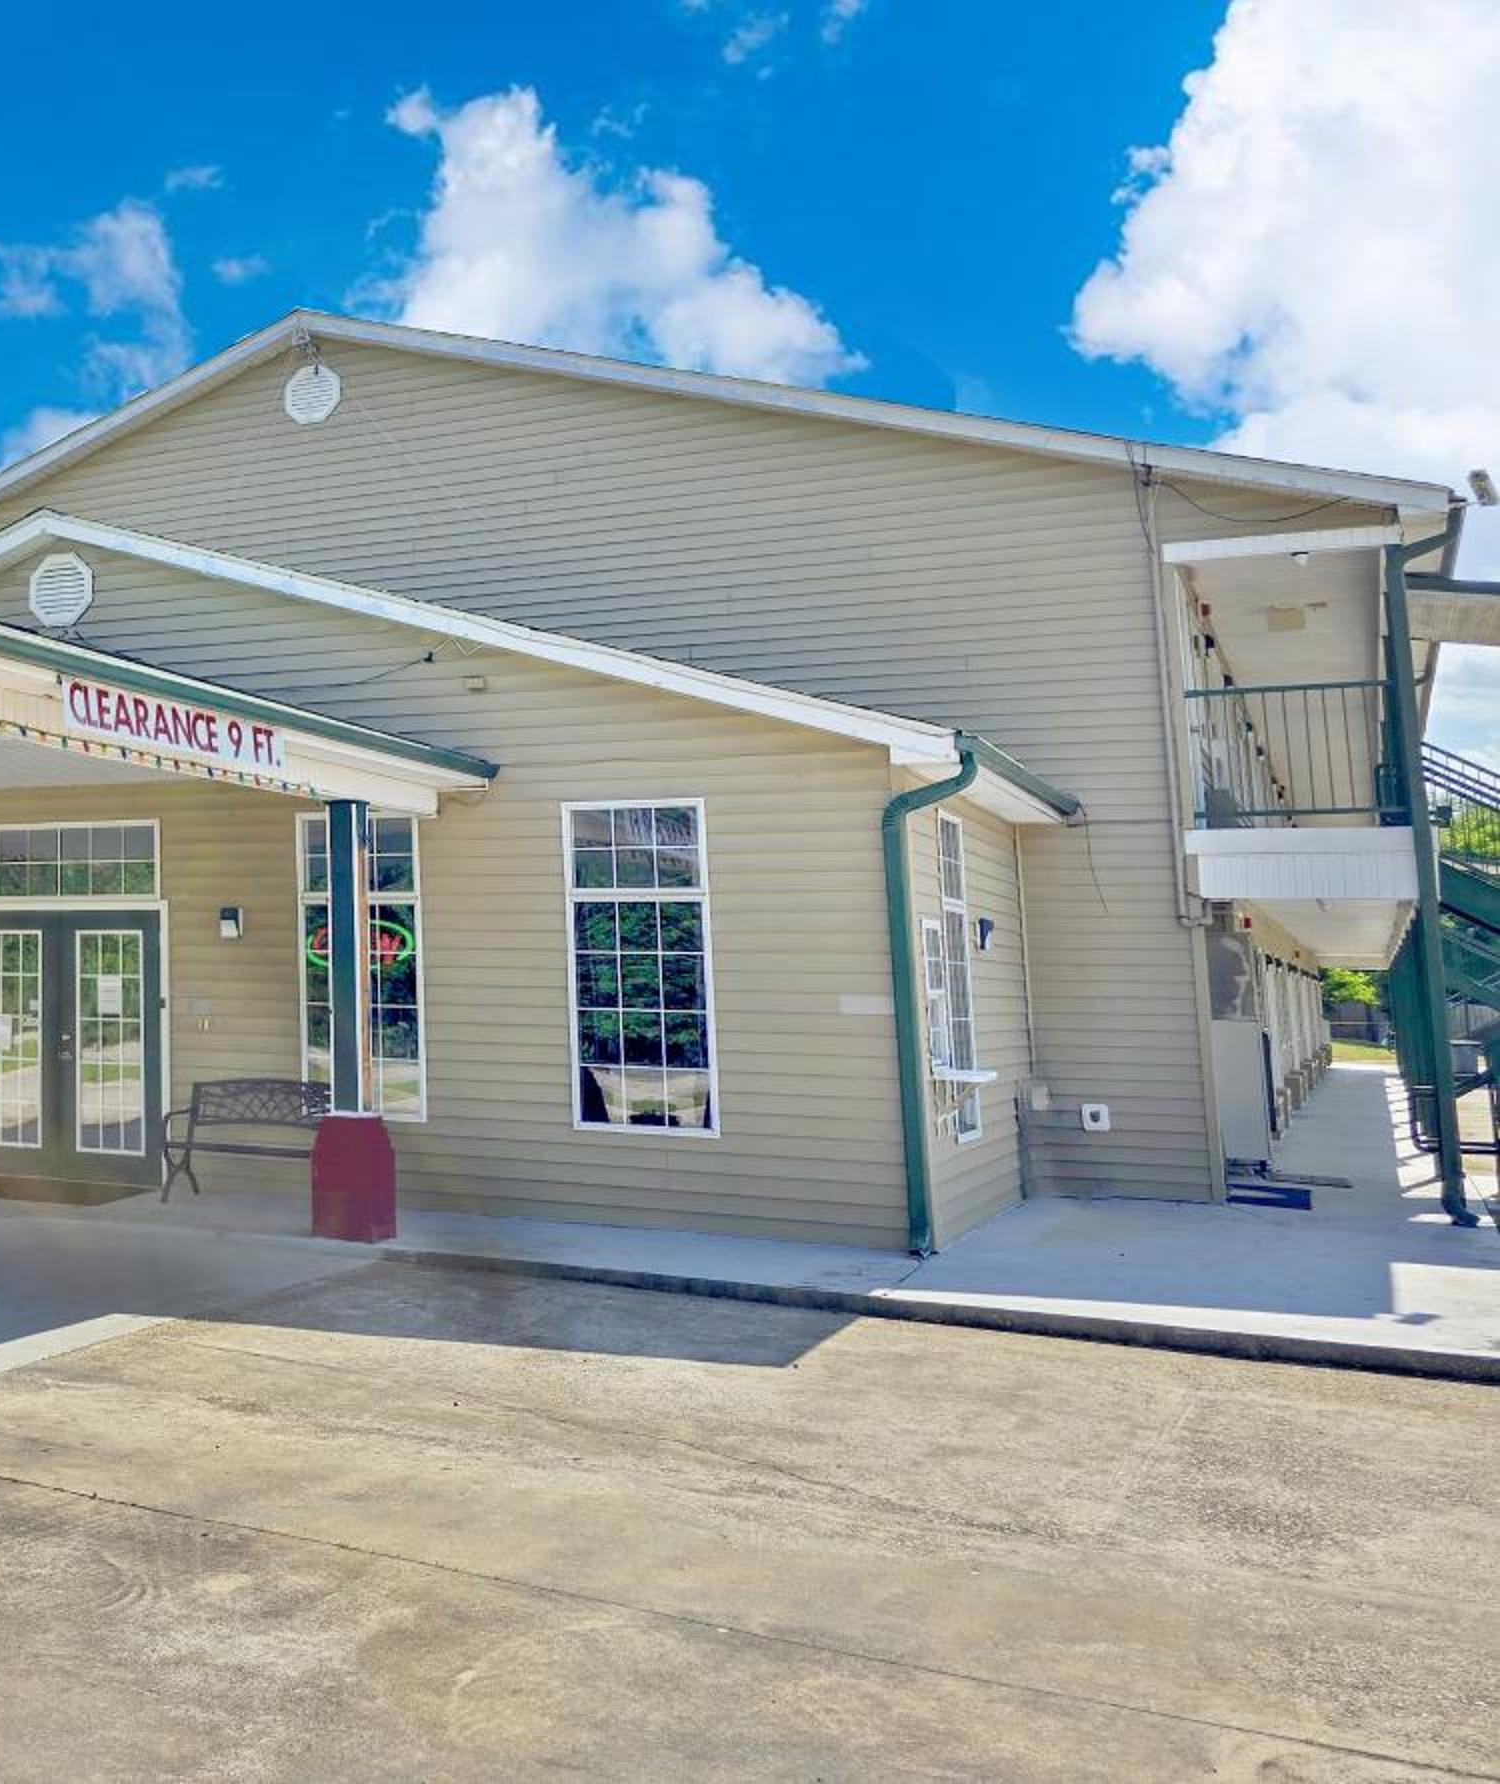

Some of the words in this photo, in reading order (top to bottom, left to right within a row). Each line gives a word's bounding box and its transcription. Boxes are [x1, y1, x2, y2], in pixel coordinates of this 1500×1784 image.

[69, 682, 219, 753] CLEARANCE
[228, 721, 243, 758] 9
[252, 726, 281, 768] FT.
